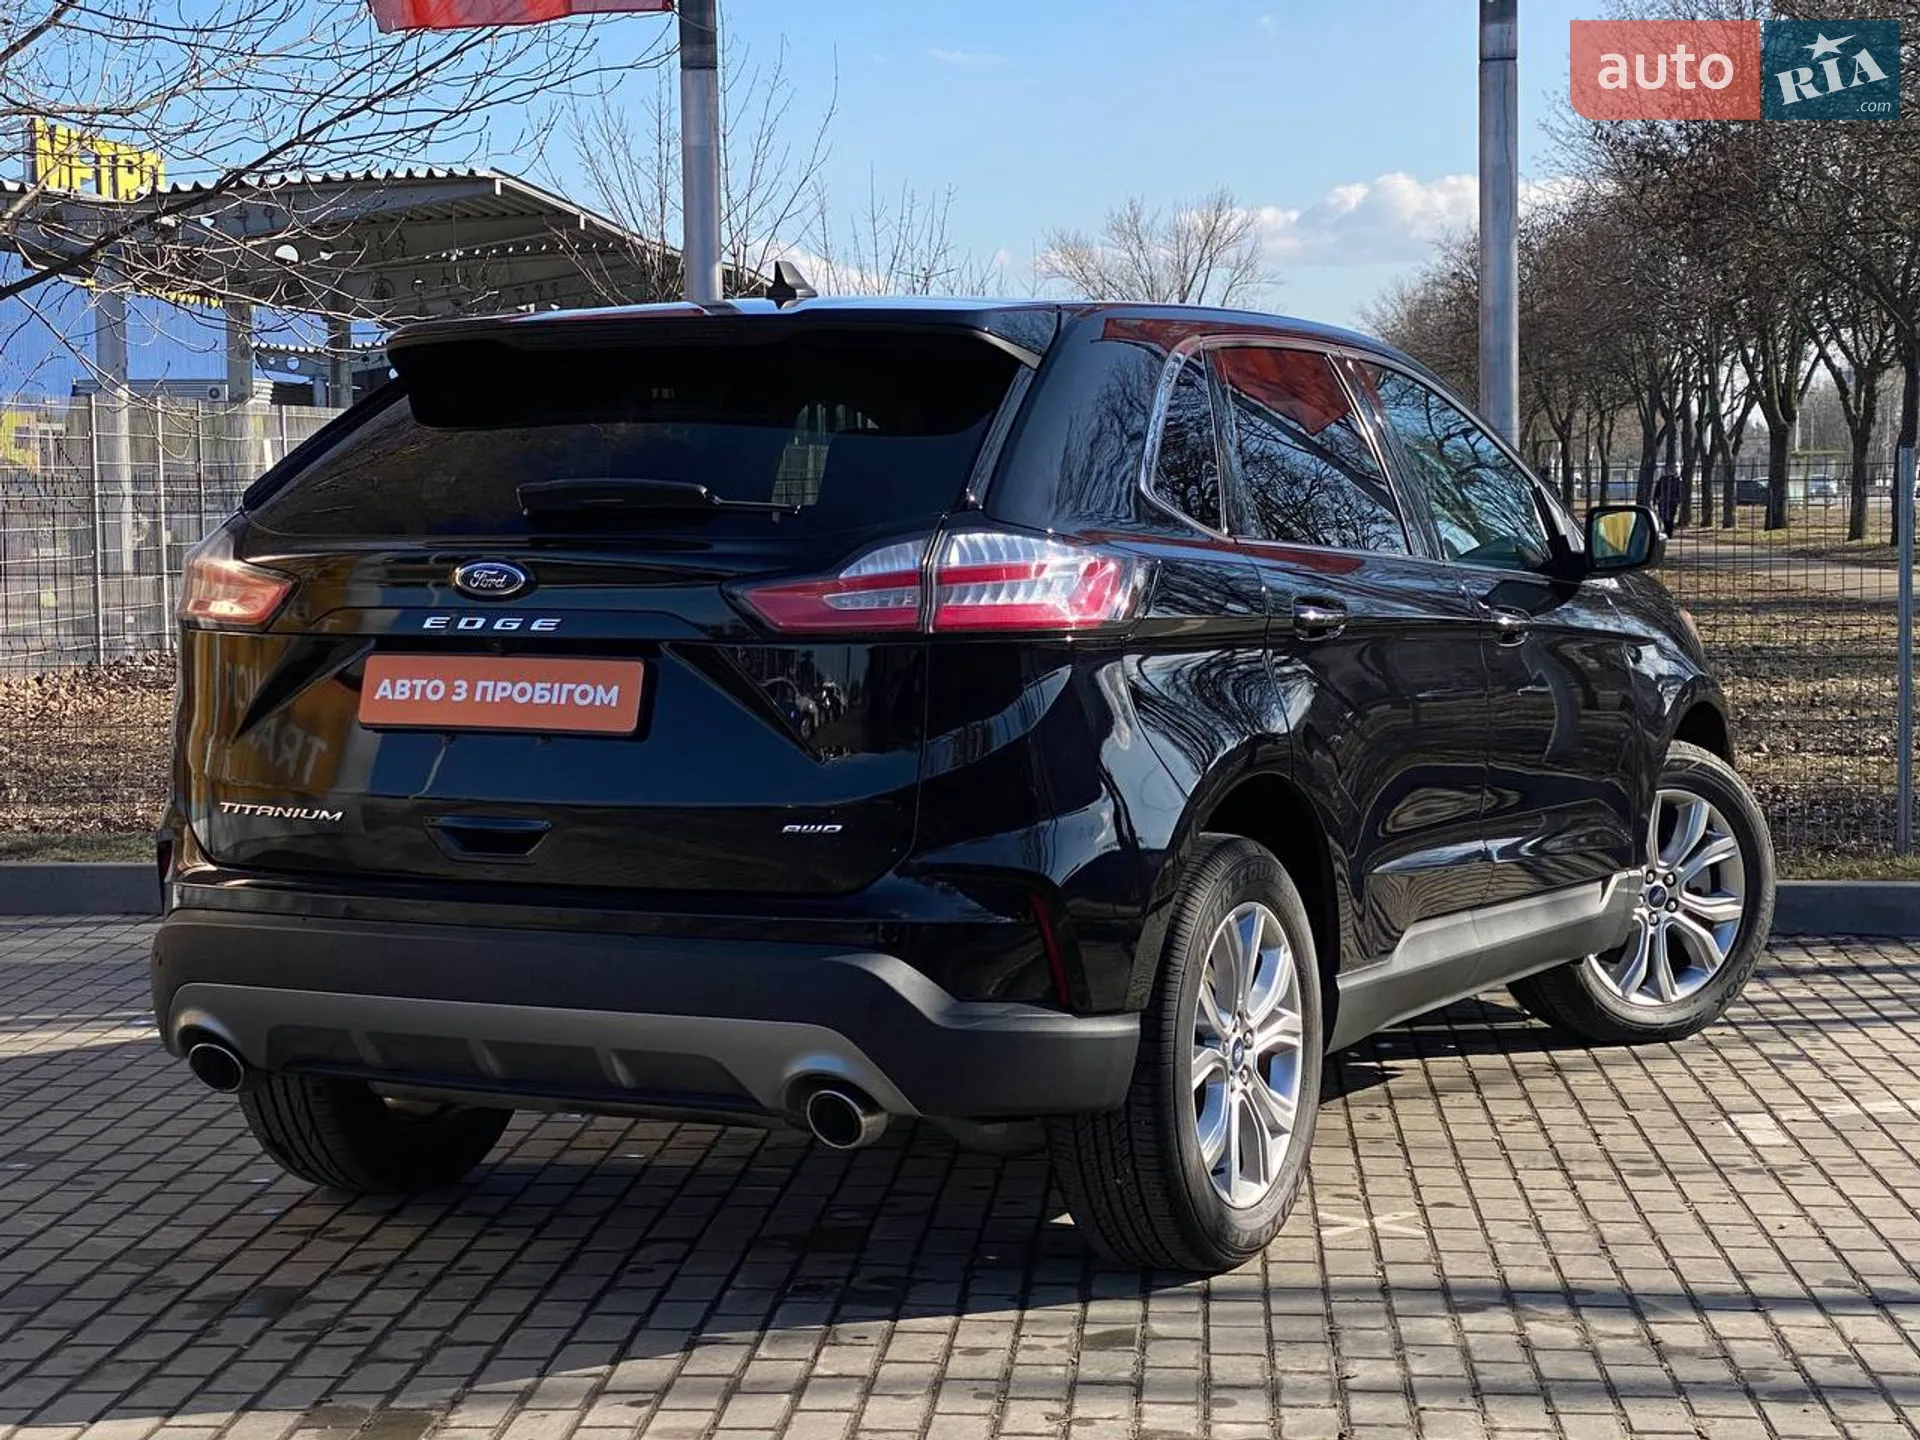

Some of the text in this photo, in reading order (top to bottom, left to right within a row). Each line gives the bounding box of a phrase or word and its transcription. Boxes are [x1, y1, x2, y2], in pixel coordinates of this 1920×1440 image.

[469, 569, 507, 588] Ford
[423, 616, 561, 631] EDGE
[374, 678, 619, 707] АВТО З ПРОБІГОМ
[220, 802, 343, 821] TITANIUM
[781, 824, 843, 834] AWD
